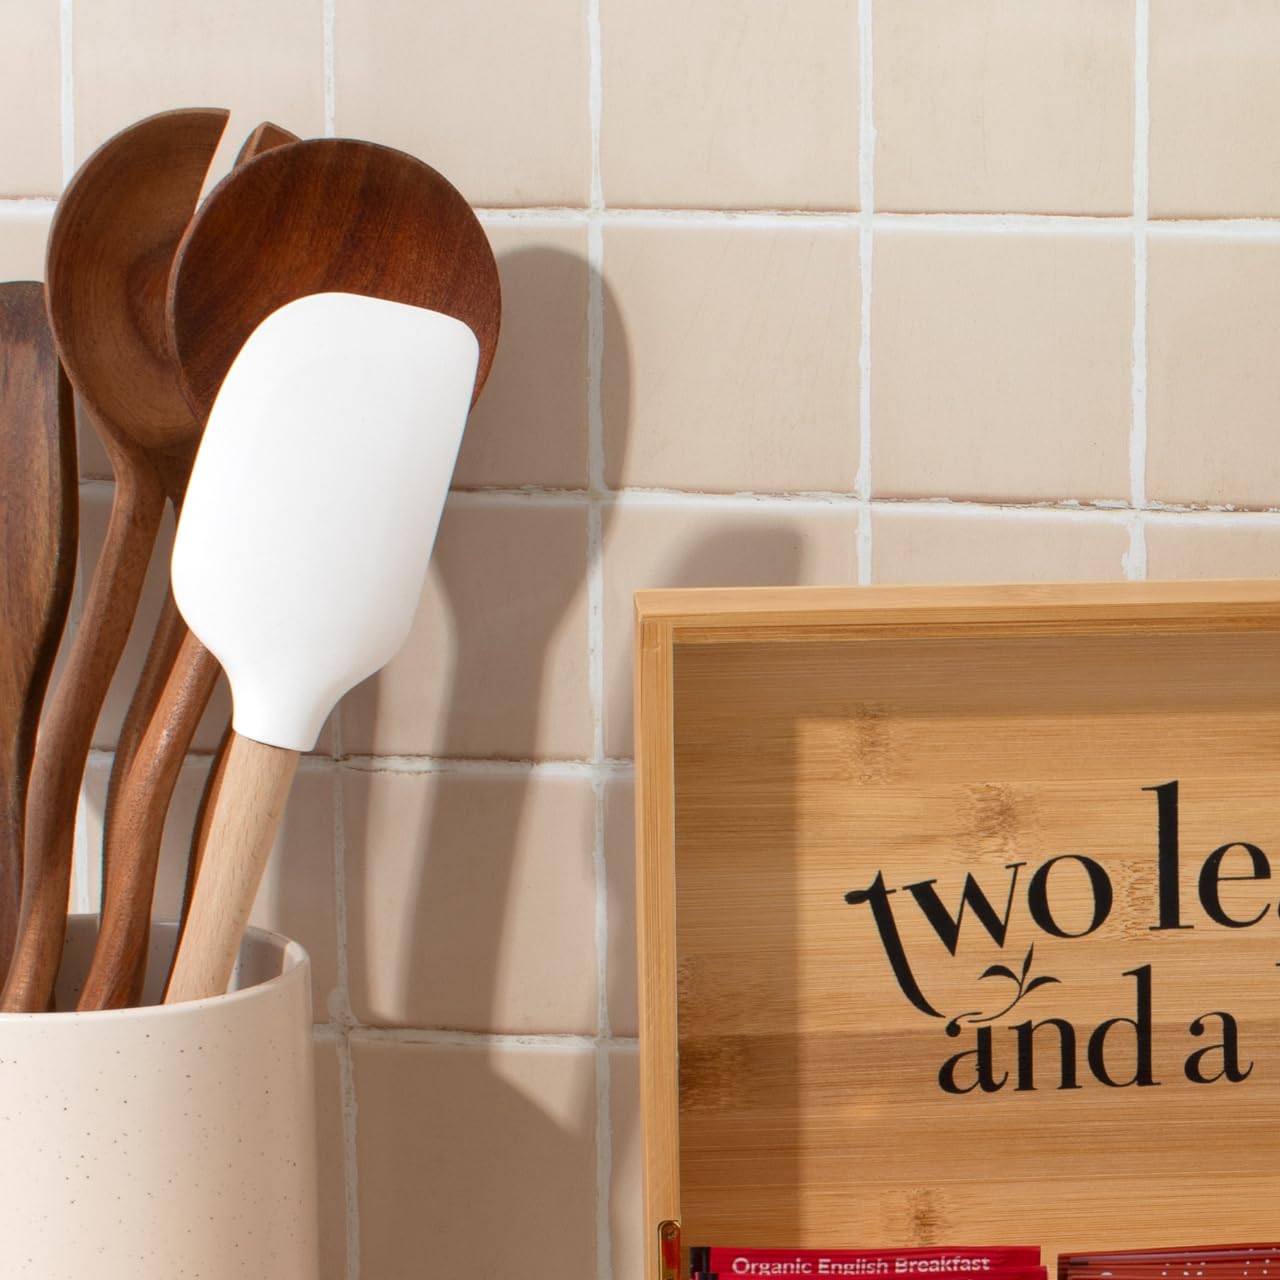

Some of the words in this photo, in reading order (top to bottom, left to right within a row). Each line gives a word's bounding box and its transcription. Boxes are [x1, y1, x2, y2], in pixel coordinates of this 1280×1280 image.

[844, 852, 1113, 1018] two
[938, 963, 1161, 1095] and
[1184, 1011, 1254, 1083] a
[732, 1257, 812, 1275] Organic
[818, 1258, 889, 1275] English
[895, 1255, 991, 1273] Breakfast
